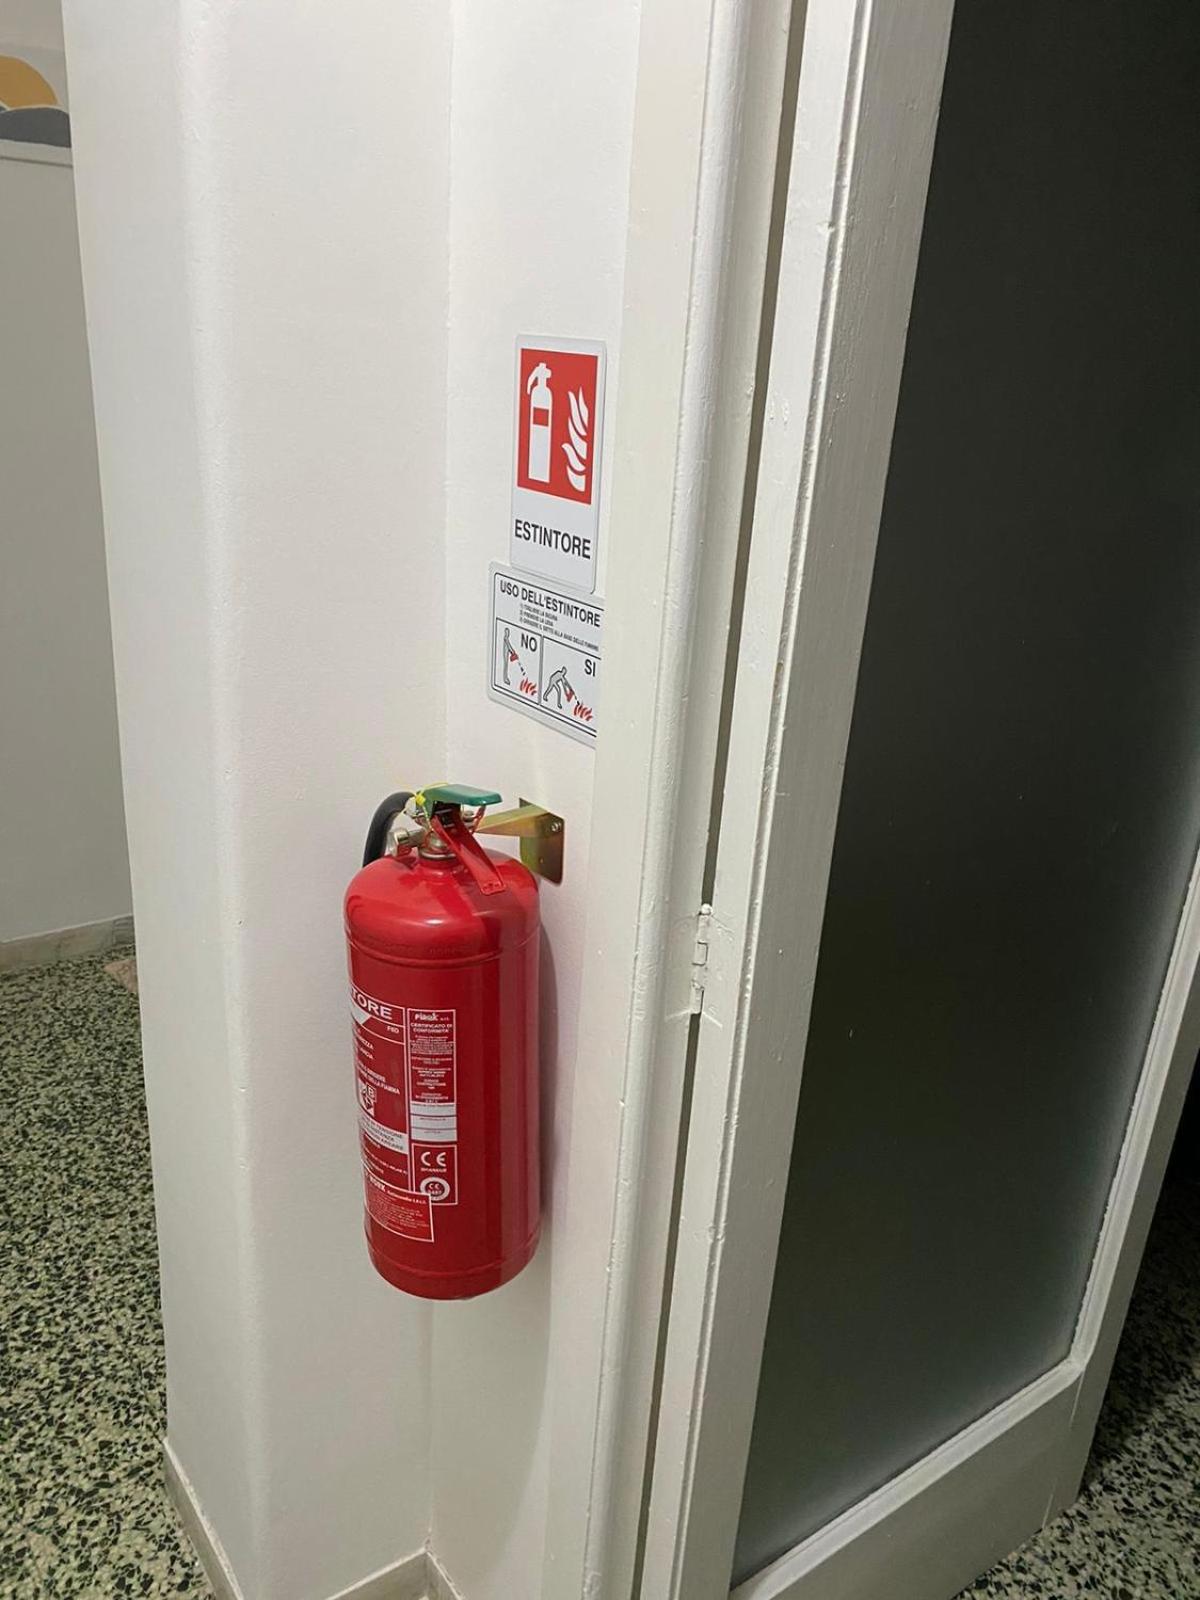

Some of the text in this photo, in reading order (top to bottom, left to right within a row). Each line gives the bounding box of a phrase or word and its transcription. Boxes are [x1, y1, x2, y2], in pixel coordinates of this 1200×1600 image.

[515, 519, 591, 559] ESTINTORE
[500, 580, 601, 628] USO DELL'ESTINTORE
[521, 633, 537, 652] NO
[584, 659, 596, 677] SI
[420, 1151, 447, 1167] CE
